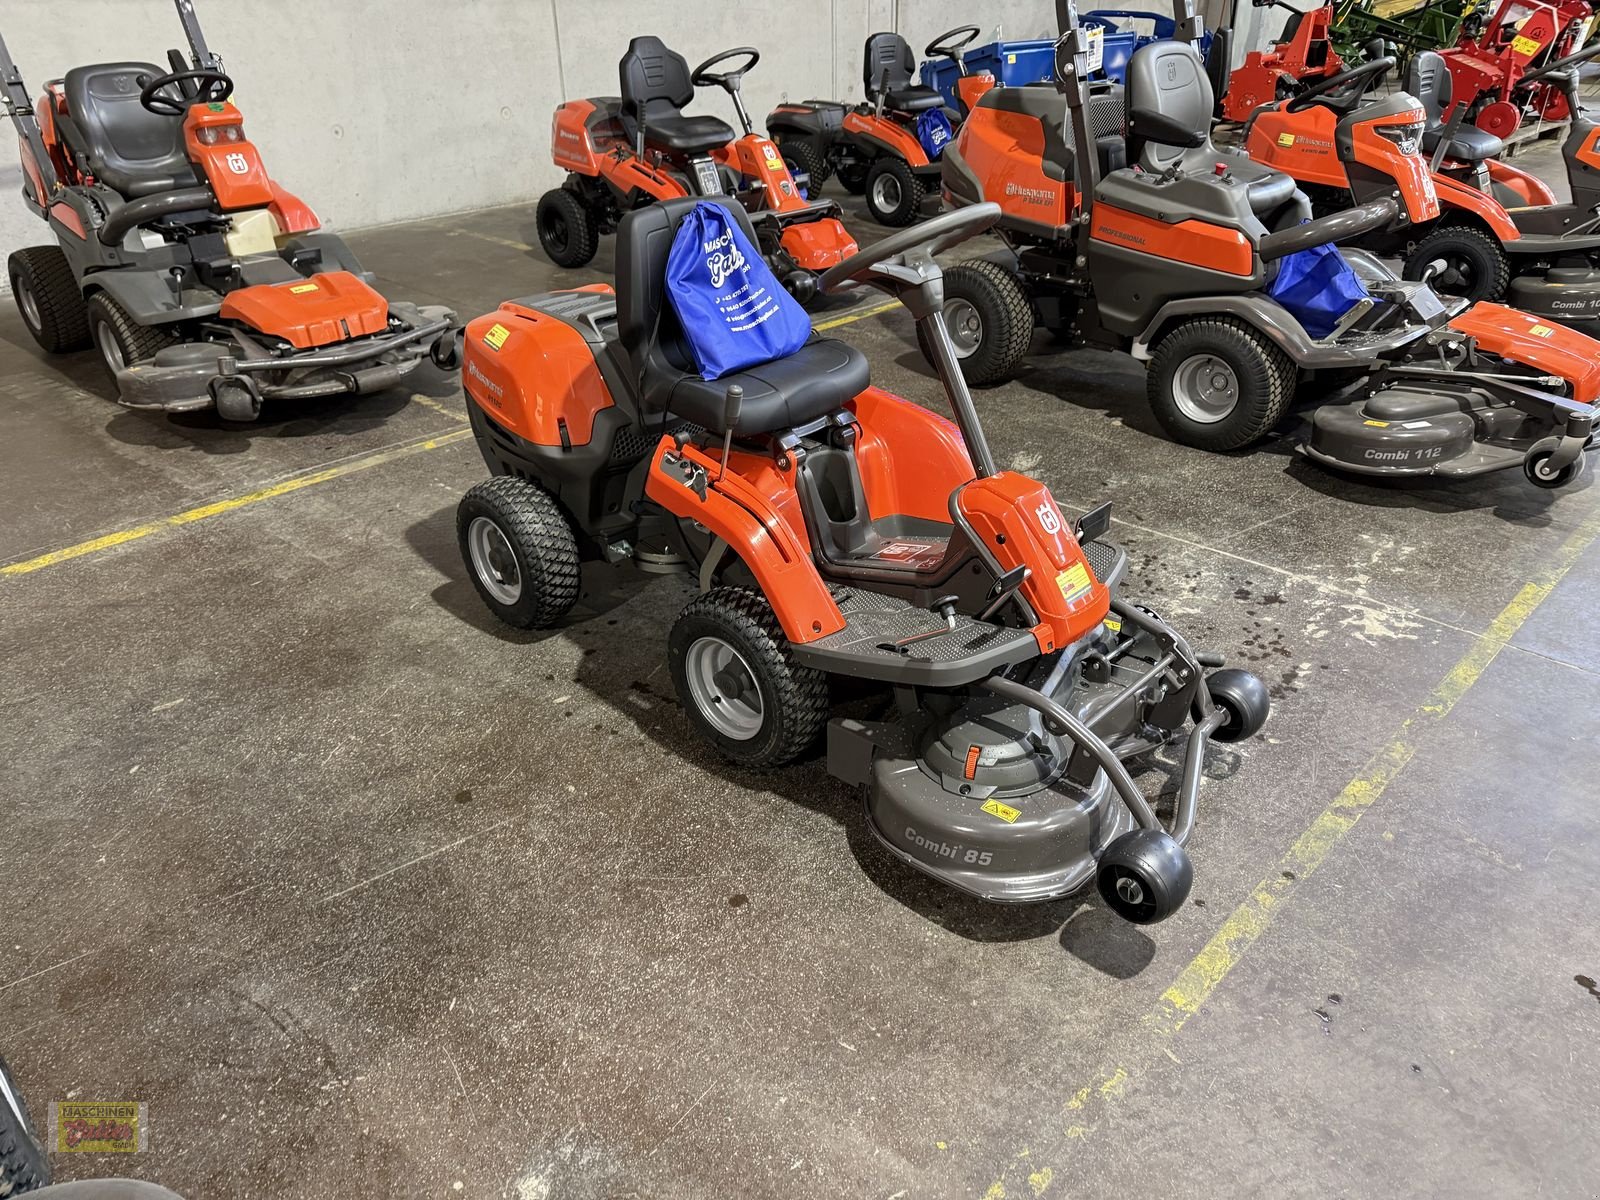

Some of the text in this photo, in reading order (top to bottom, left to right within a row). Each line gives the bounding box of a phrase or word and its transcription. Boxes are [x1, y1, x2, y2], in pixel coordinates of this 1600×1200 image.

[1098, 225, 1147, 245] PROFESSIONAL
[1551, 300, 1587, 309] Combi
[1364, 447, 1442, 461] Combi 112
[963, 849, 994, 866] 85
